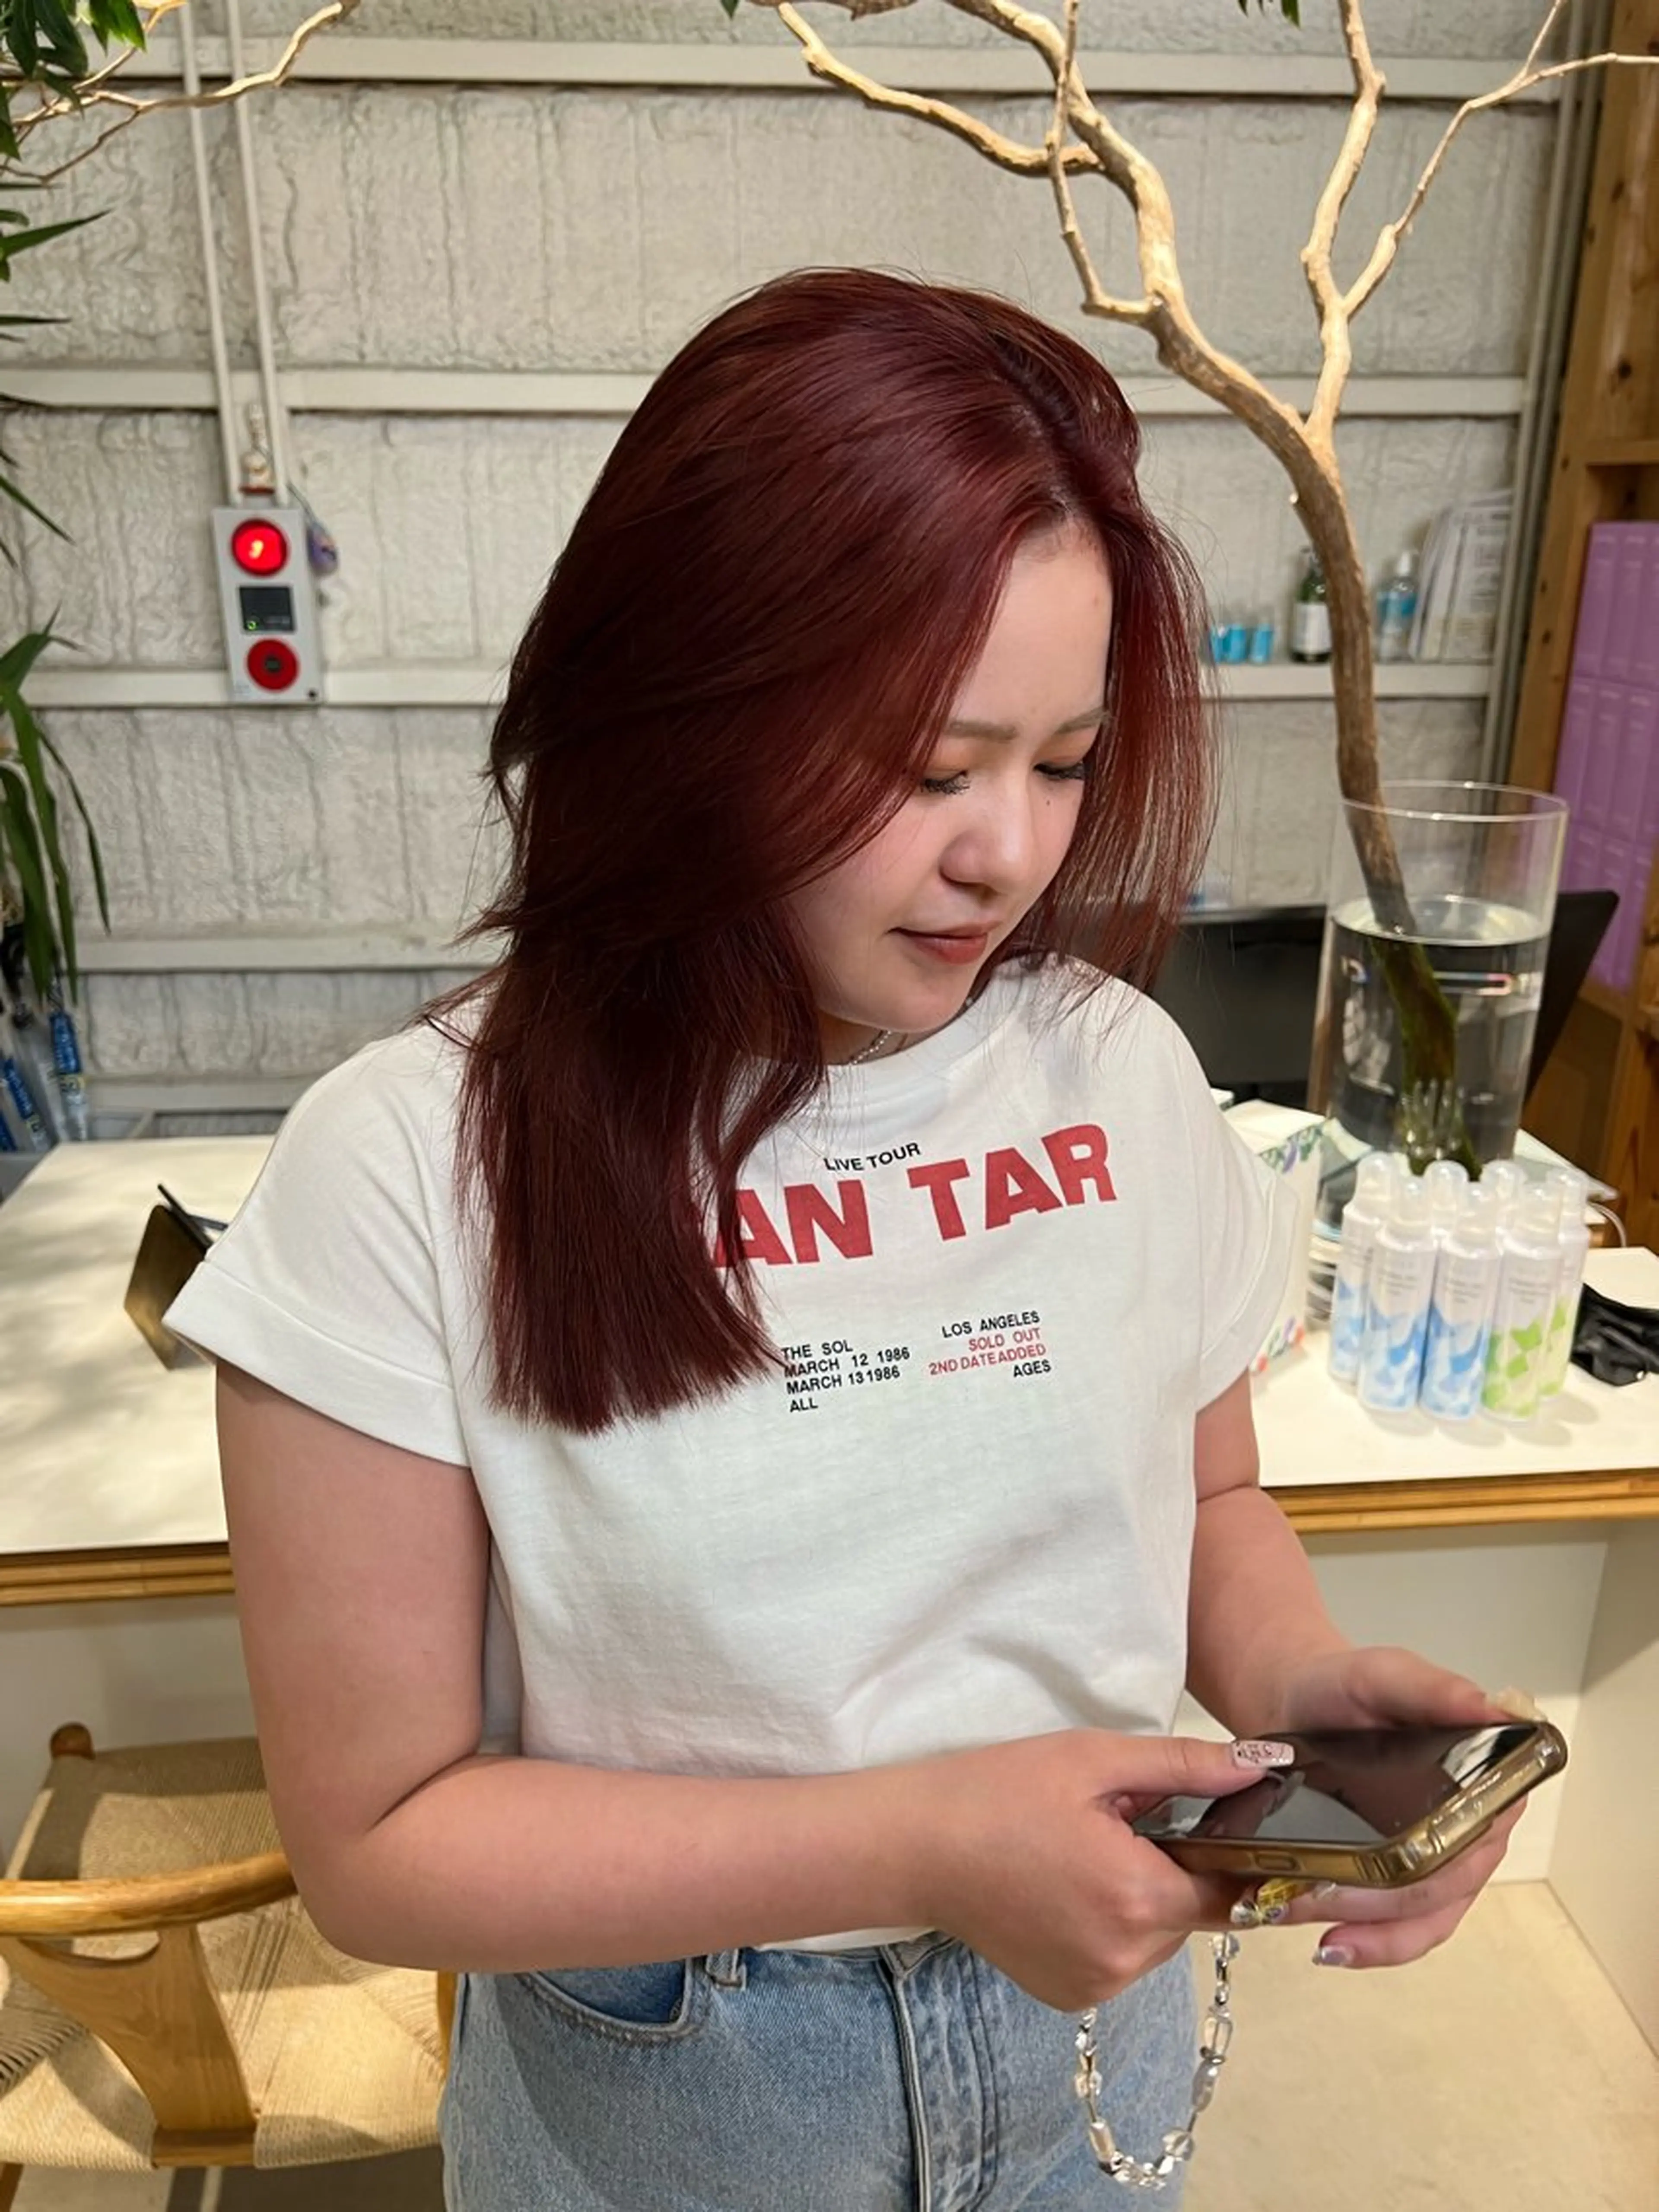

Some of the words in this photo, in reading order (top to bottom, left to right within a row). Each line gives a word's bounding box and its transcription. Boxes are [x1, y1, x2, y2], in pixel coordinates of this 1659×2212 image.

[823, 1157, 864, 1171] LIVE
[866, 1143, 921, 1168] TOUR
[906, 1124, 1117, 1241] TAR
[942, 1322, 972, 1338] LOS
[980, 1311, 1040, 1331] ANGELES
[781, 1344, 812, 1360] THE
[821, 1340, 853, 1355] SOL
[969, 1334, 1004, 1351] SOLD
[1013, 1328, 1041, 1344] OUT
[784, 1358, 839, 1377] MARCH
[852, 1353, 868, 1367] 12
[877, 1347, 910, 1363] 1986
[1014, 1359, 1051, 1377] AGES
[787, 1374, 842, 1394] MARCH
[848, 1372, 863, 1385] 13
[867, 1365, 900, 1382] 1986
[790, 1398, 818, 1412] ALL
